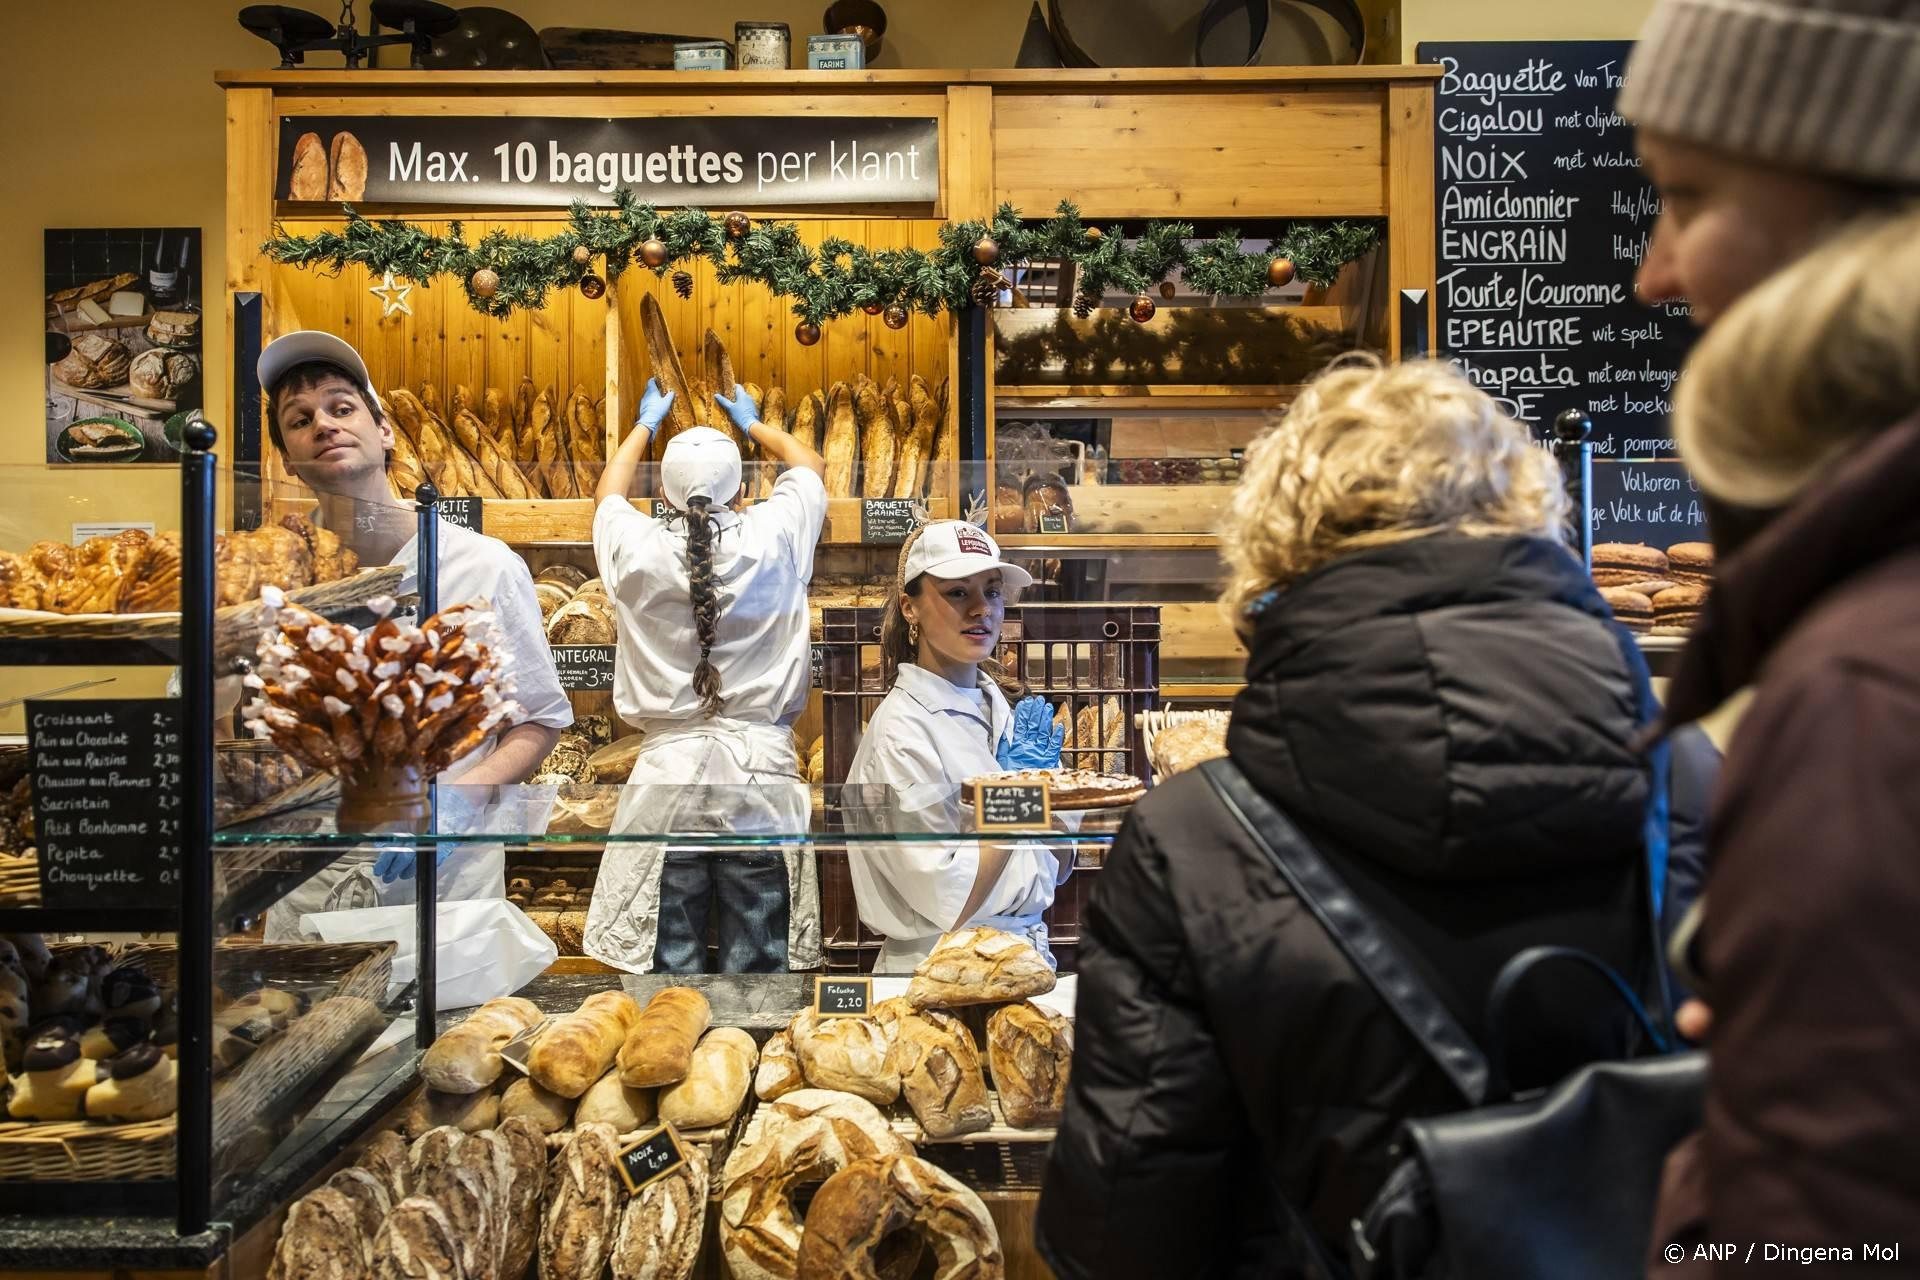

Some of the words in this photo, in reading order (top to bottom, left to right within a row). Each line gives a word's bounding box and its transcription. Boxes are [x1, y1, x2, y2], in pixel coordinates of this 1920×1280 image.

[818, 60, 846, 69] FARINE
[1439, 57, 1567, 106] Baguette
[1555, 110, 1582, 128] met
[388, 141, 480, 183] Max.
[494, 141, 538, 183] 10
[549, 140, 744, 193] baguettes
[757, 150, 817, 193] per
[830, 140, 920, 183] klant
[1553, 149, 1587, 171] met
[1441, 186, 1580, 228] Amidonnier
[1437, 267, 1627, 319] Tourte/Couronne
[1447, 317, 1583, 347] EPEAUTRE
[1592, 324, 1616, 342] wit
[1621, 322, 1663, 349] spelt
[1588, 361, 1613, 384] met
[1615, 368, 1636, 382] een
[1588, 394, 1618, 413] met
[1624, 391, 1680, 414] boekw
[1590, 433, 1617, 455] met
[1621, 467, 1681, 492] Volkoren
[866, 500, 915, 510] BAGUETTE
[866, 509, 910, 517] GRAINES
[1647, 502, 1666, 523] uit
[1670, 505, 1684, 523] de
[552, 648, 614, 664] INTEGRAL
[33, 712, 114, 728] Croissant
[34, 731, 57, 748] Pain
[59, 737, 74, 746] au
[76, 731, 129, 747] Chocolat
[36, 752, 60, 768] Pain
[62, 758, 82, 768] aux
[84, 751, 128, 770] Raisins
[37, 773, 86, 789] Chausson
[40, 796, 111, 812] Sacristain
[78, 817, 148, 835] Bonhomme
[47, 843, 105, 866] Pepita
[48, 866, 145, 891] Chouquette
[836, 997, 863, 1009] 2,20
